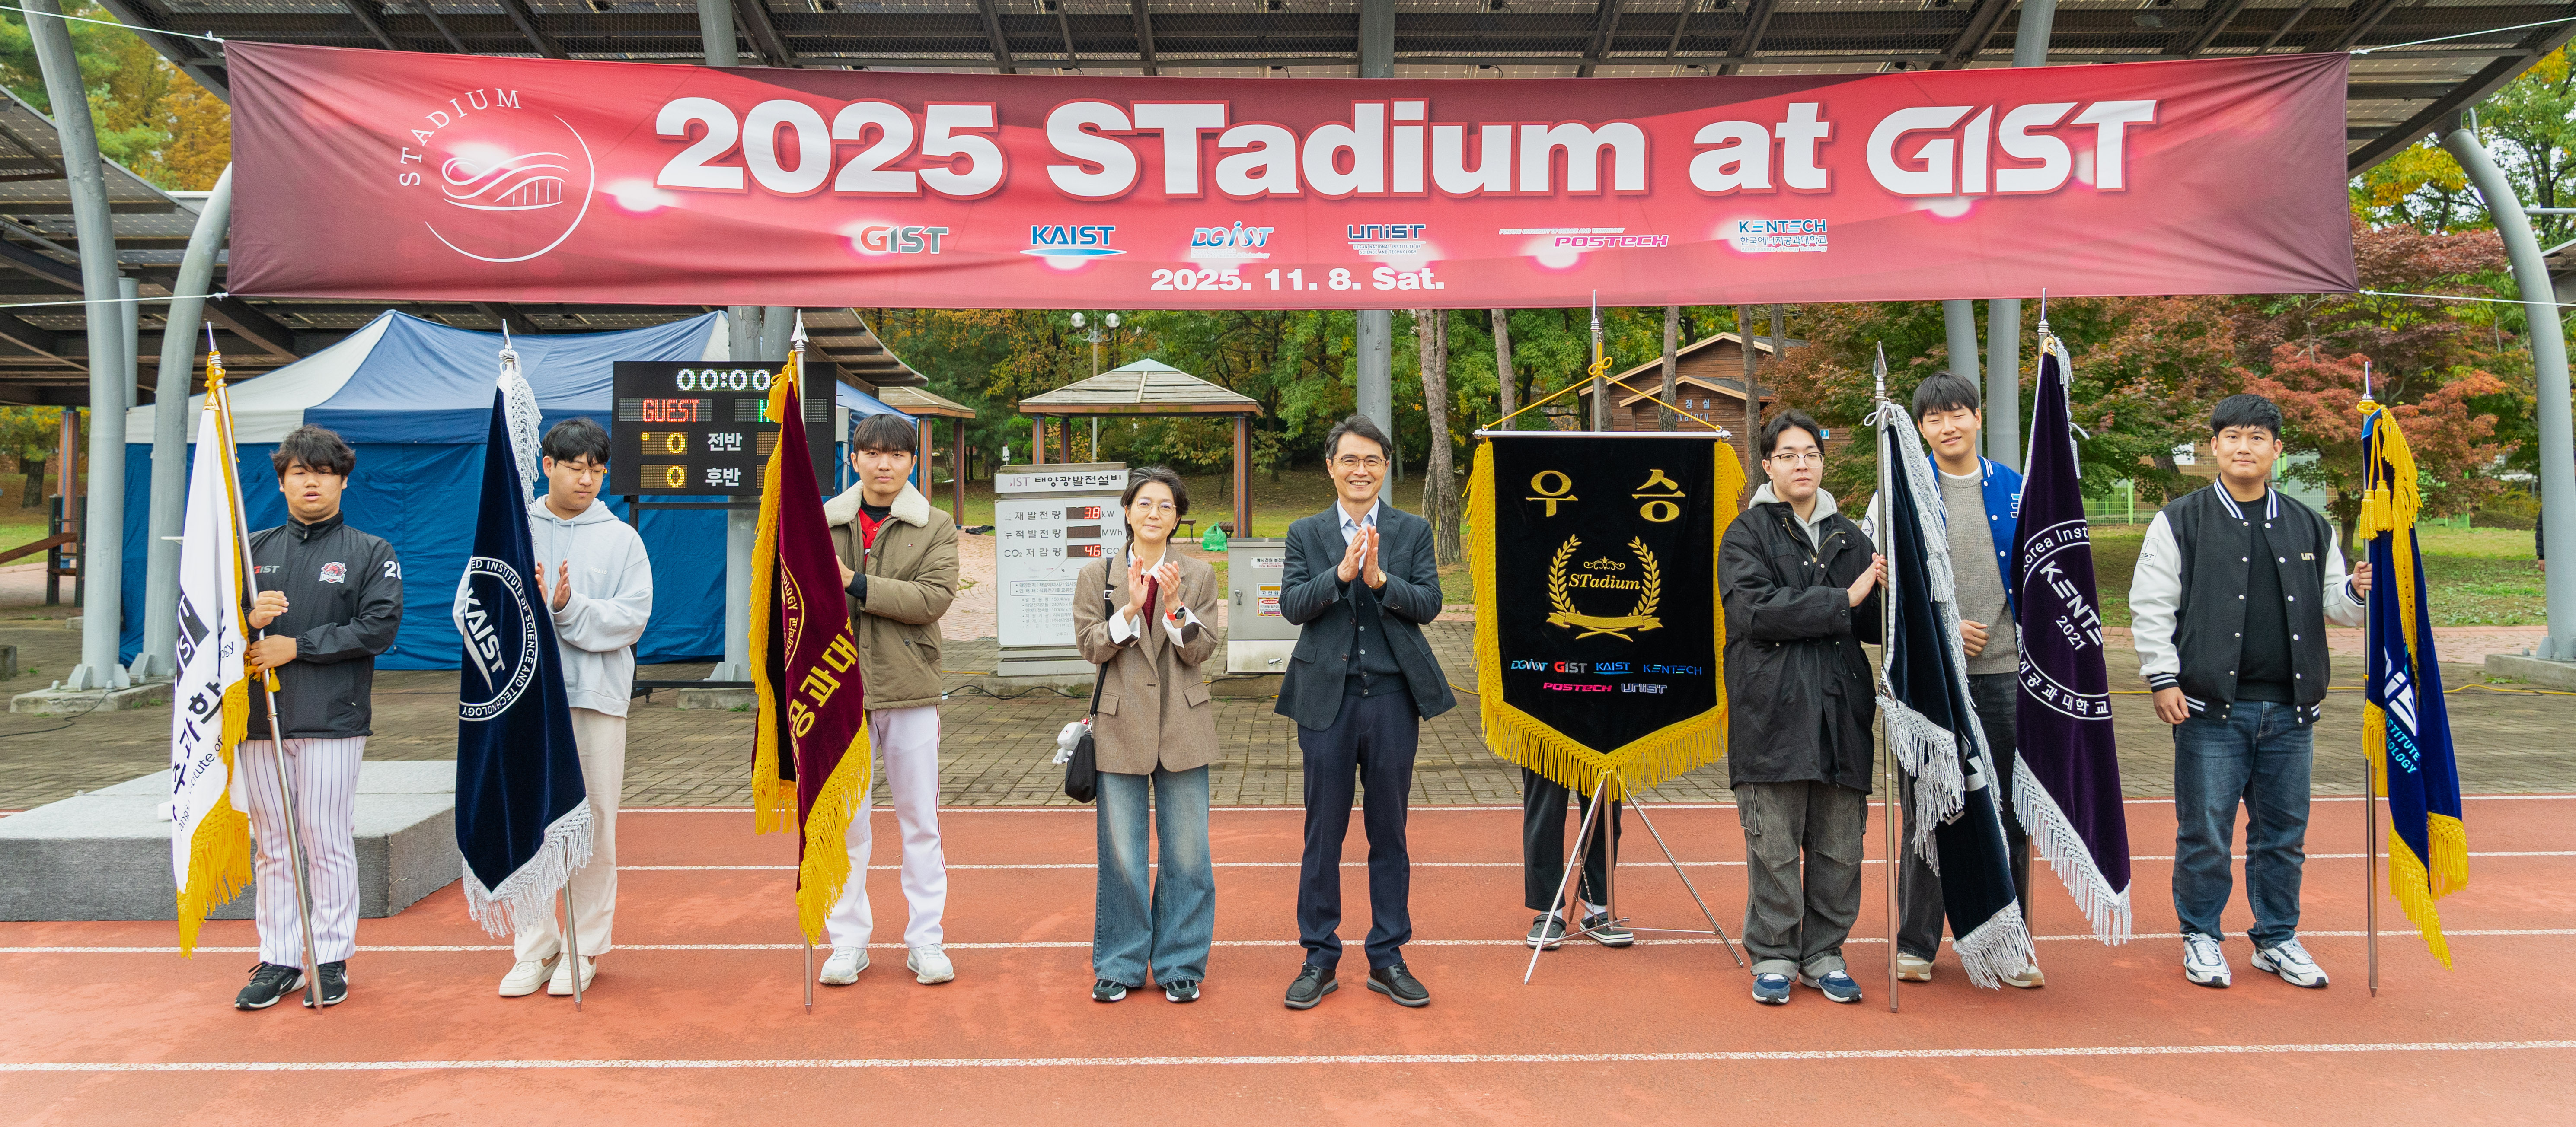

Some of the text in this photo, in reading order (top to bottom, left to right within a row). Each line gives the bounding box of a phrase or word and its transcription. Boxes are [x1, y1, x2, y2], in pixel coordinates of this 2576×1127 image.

[399, 88, 523, 187] STADIUM
[655, 97, 1829, 196] 2025 STadium at
[1866, 99, 2157, 195] GIST
[1031, 225, 1116, 245] KAIST
[1739, 219, 1826, 233] KENTECH
[860, 226, 949, 254] GIST
[1740, 235, 1828, 245] 한국에너지공과대학교
[1151, 267, 1445, 291] 2025. 11. 8. Sat.
[677, 369, 771, 392] 00:00
[642, 399, 699, 423] GUEST
[707, 432, 742, 452] 전반
[666, 465, 685, 487] 0
[705, 468, 741, 487] 후반
[1010, 475, 1121, 487] IST 태양광발전설비
[2023, 537, 2054, 573] orea
[486, 560, 523, 598] INSTITUTE
[1568, 573, 1641, 591] STadium
[521, 597, 528, 612] OF
[464, 587, 505, 673] KAIST
[525, 615, 536, 664] SCIENCE
[2056, 615, 2088, 651] 2021
[515, 665, 532, 688] AND
[1554, 661, 1588, 674] GIST
[1596, 662, 1631, 672] KAIST
[1644, 664, 1702, 675] KENTECH
[461, 687, 518, 717] TECHNOLOGY
